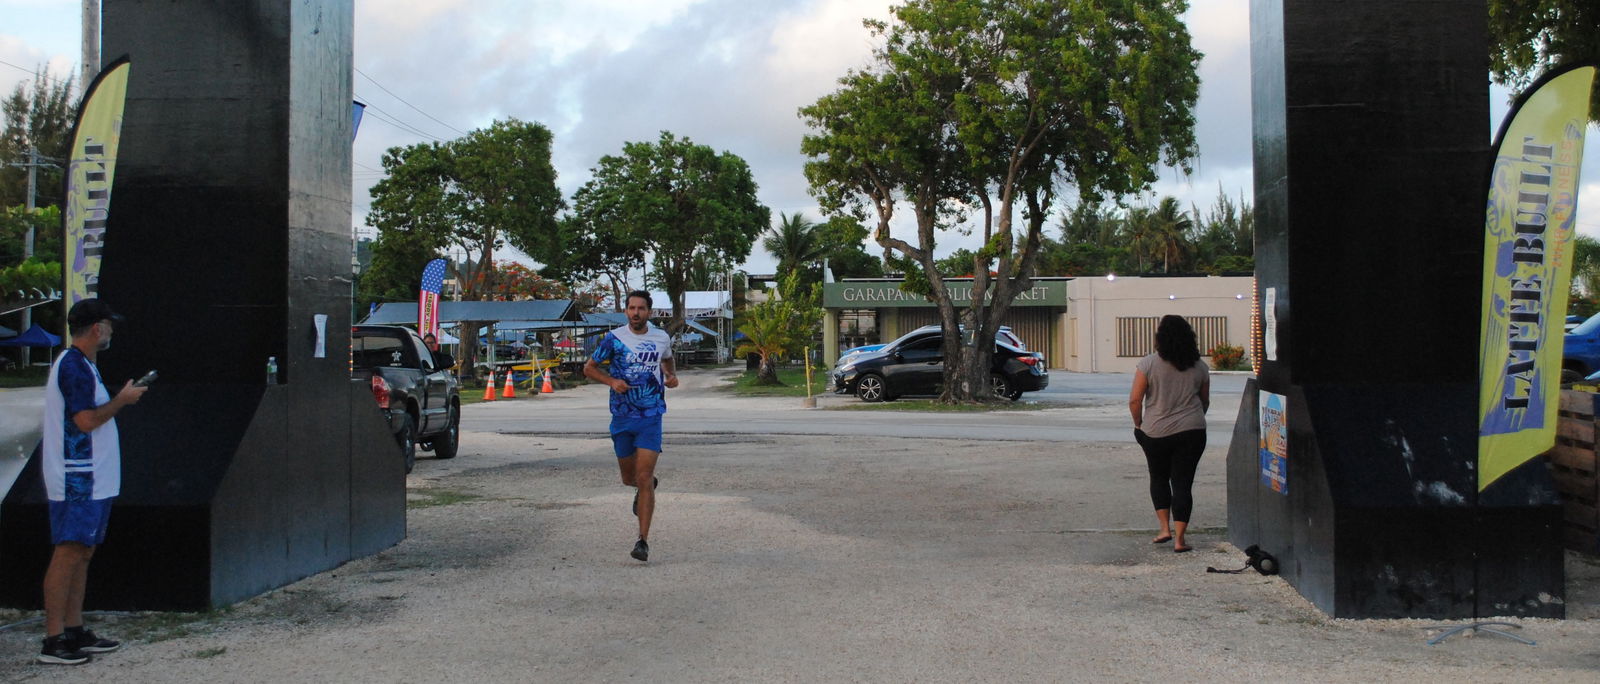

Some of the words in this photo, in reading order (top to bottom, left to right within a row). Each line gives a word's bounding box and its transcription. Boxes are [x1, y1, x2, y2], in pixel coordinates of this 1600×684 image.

[1512, 136, 1553, 265] BUILT
[1554, 139, 1575, 221] FITNESS
[843, 287, 918, 301] GARAPAN
[626, 351, 660, 363] RUN
[1504, 278, 1542, 410] LATTE
